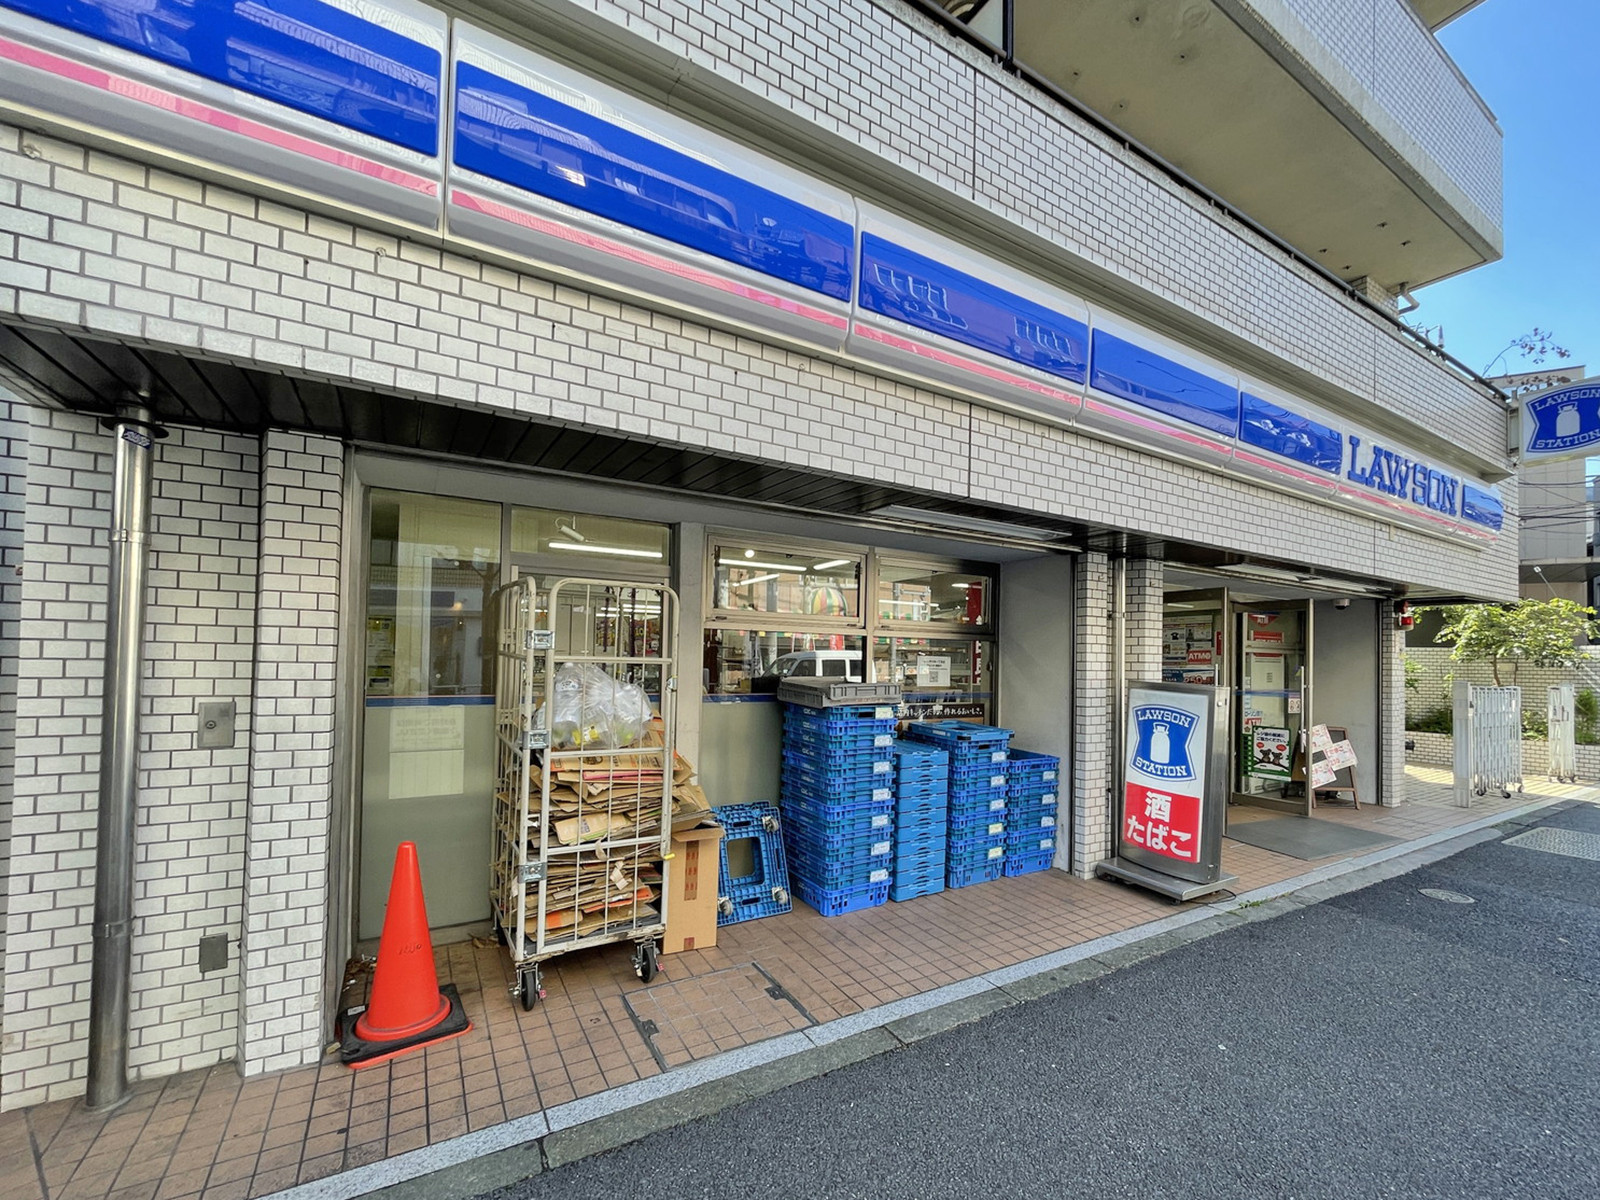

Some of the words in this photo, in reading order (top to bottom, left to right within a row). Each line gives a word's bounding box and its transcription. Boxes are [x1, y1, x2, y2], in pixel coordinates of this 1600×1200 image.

[1534, 388, 1600, 411] LAWSON
[1535, 428, 1600, 448] STATION
[1347, 435, 1458, 517] LAWSON
[1137, 709, 1192, 728] LAWSON
[1135, 756, 1188, 777] STATION
[1144, 790, 1172, 823] 酒
[1126, 815, 1192, 858] たばこ
